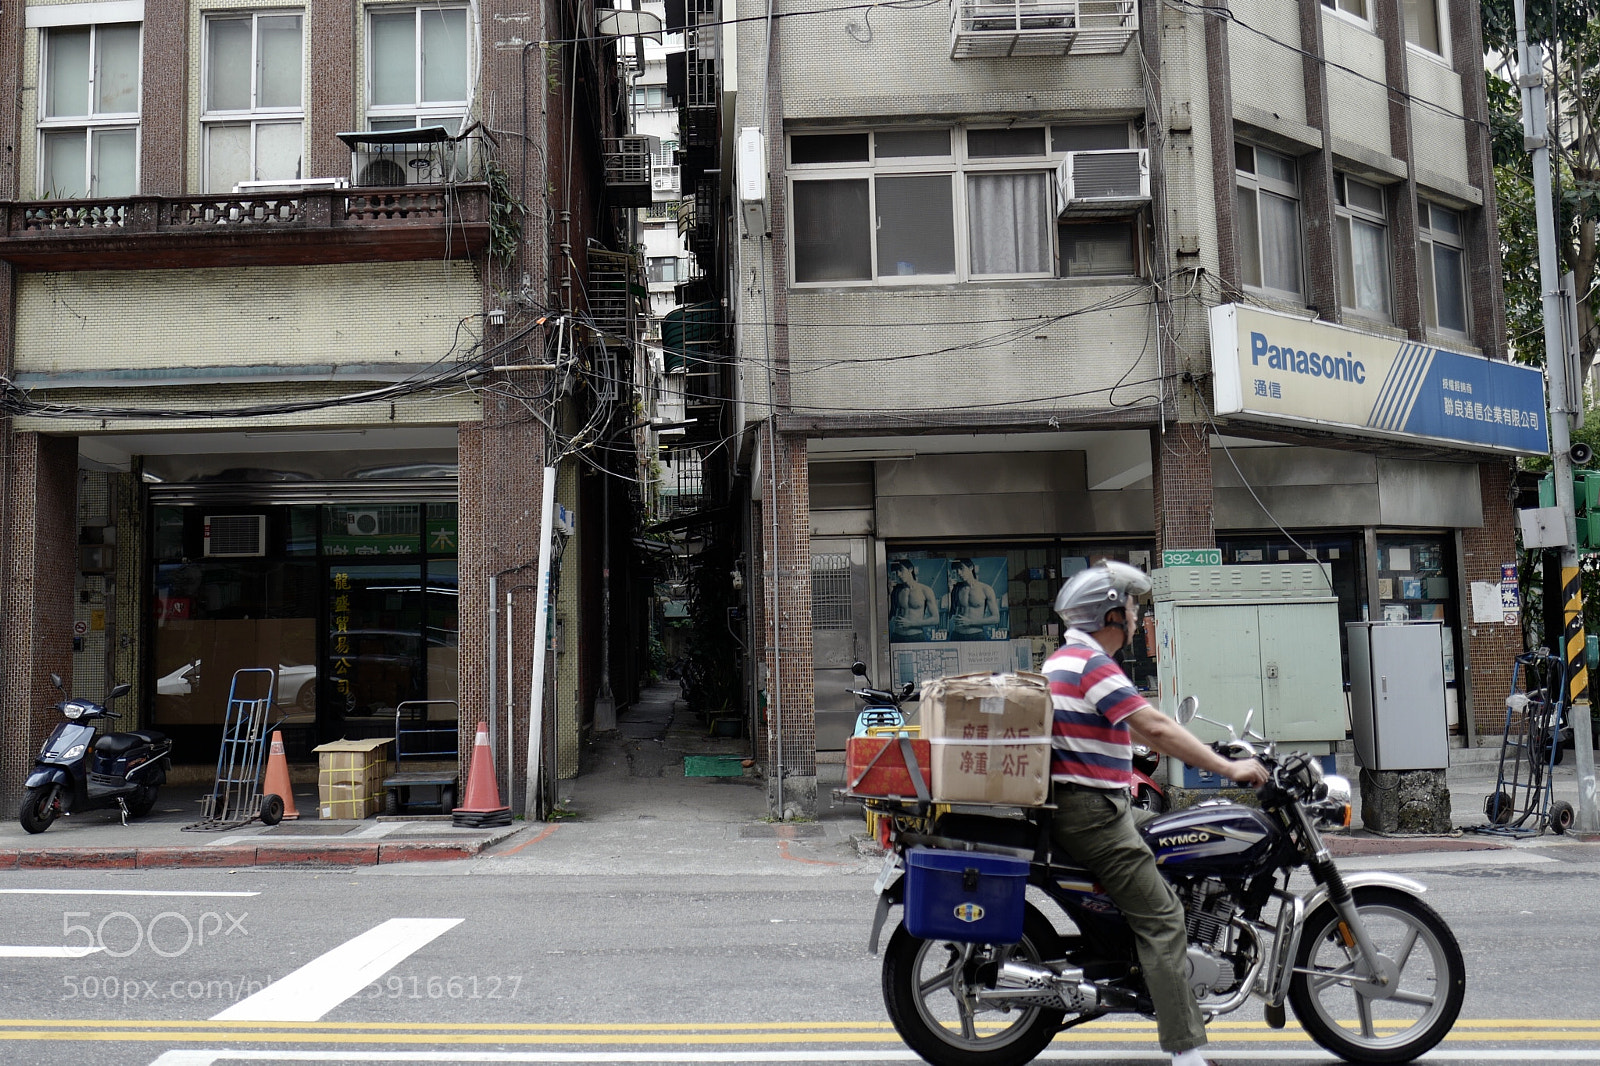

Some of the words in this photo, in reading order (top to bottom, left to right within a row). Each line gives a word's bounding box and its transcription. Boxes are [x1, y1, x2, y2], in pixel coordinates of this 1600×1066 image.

[1250, 331, 1366, 384] Panasonic
[1254, 379, 1282, 399] 通信
[1443, 397, 1540, 431] 聯良通信企業有限公司
[1164, 553, 1219, 565] 392-410
[333, 572, 352, 695] 龍盛貿易公司
[1002, 753, 1028, 777] 公斤
[1158, 832, 1210, 846] KYMCO
